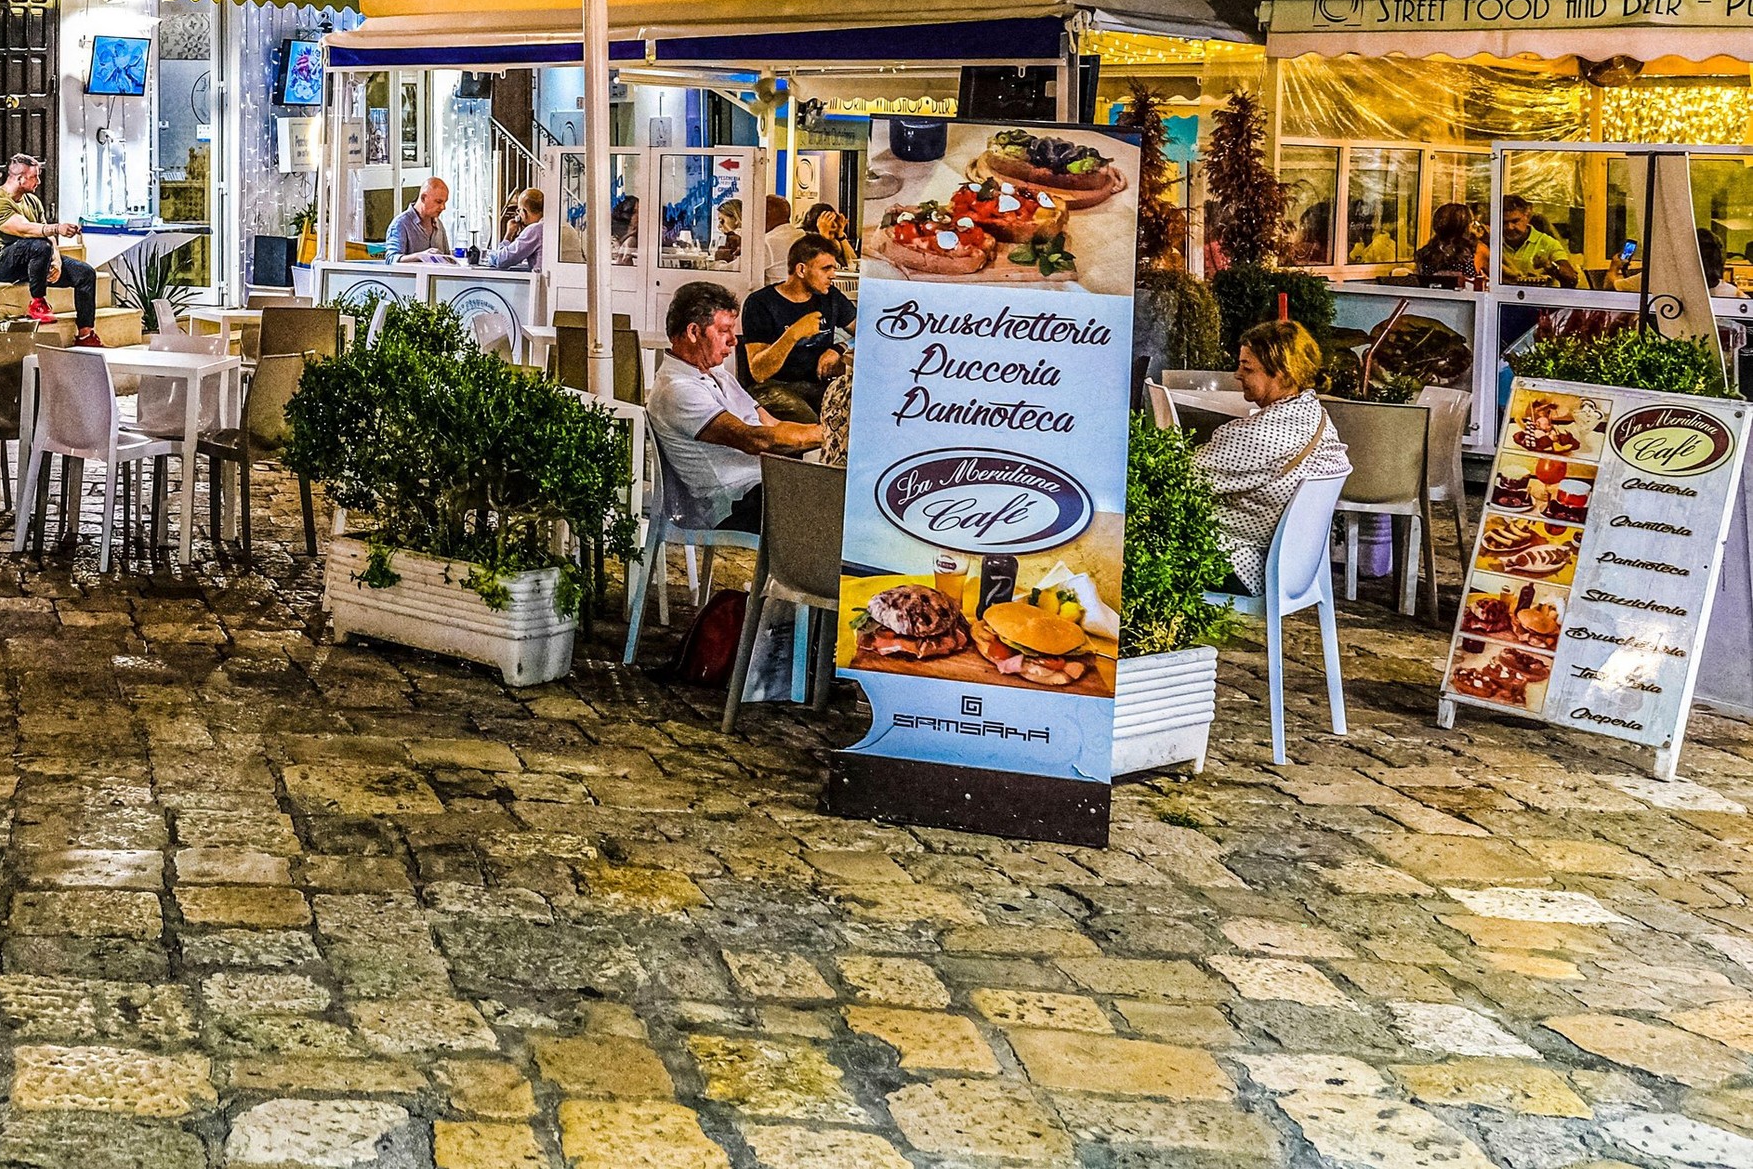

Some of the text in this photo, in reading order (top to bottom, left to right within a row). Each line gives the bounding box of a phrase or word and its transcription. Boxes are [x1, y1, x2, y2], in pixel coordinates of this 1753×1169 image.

[875, 299, 1112, 347] Bruschetteria
[908, 342, 1062, 388] Pucceria
[891, 385, 1076, 434] Paninoteca
[1619, 409, 1720, 443] La Meridiana
[1633, 434, 1703, 467] Café
[896, 457, 1062, 506] La Meridiana
[1621, 477, 1698, 499] Gelateria
[922, 492, 1038, 538] Café
[1596, 551, 1690, 579] Paninoteca
[1569, 707, 1643, 732] Creperia
